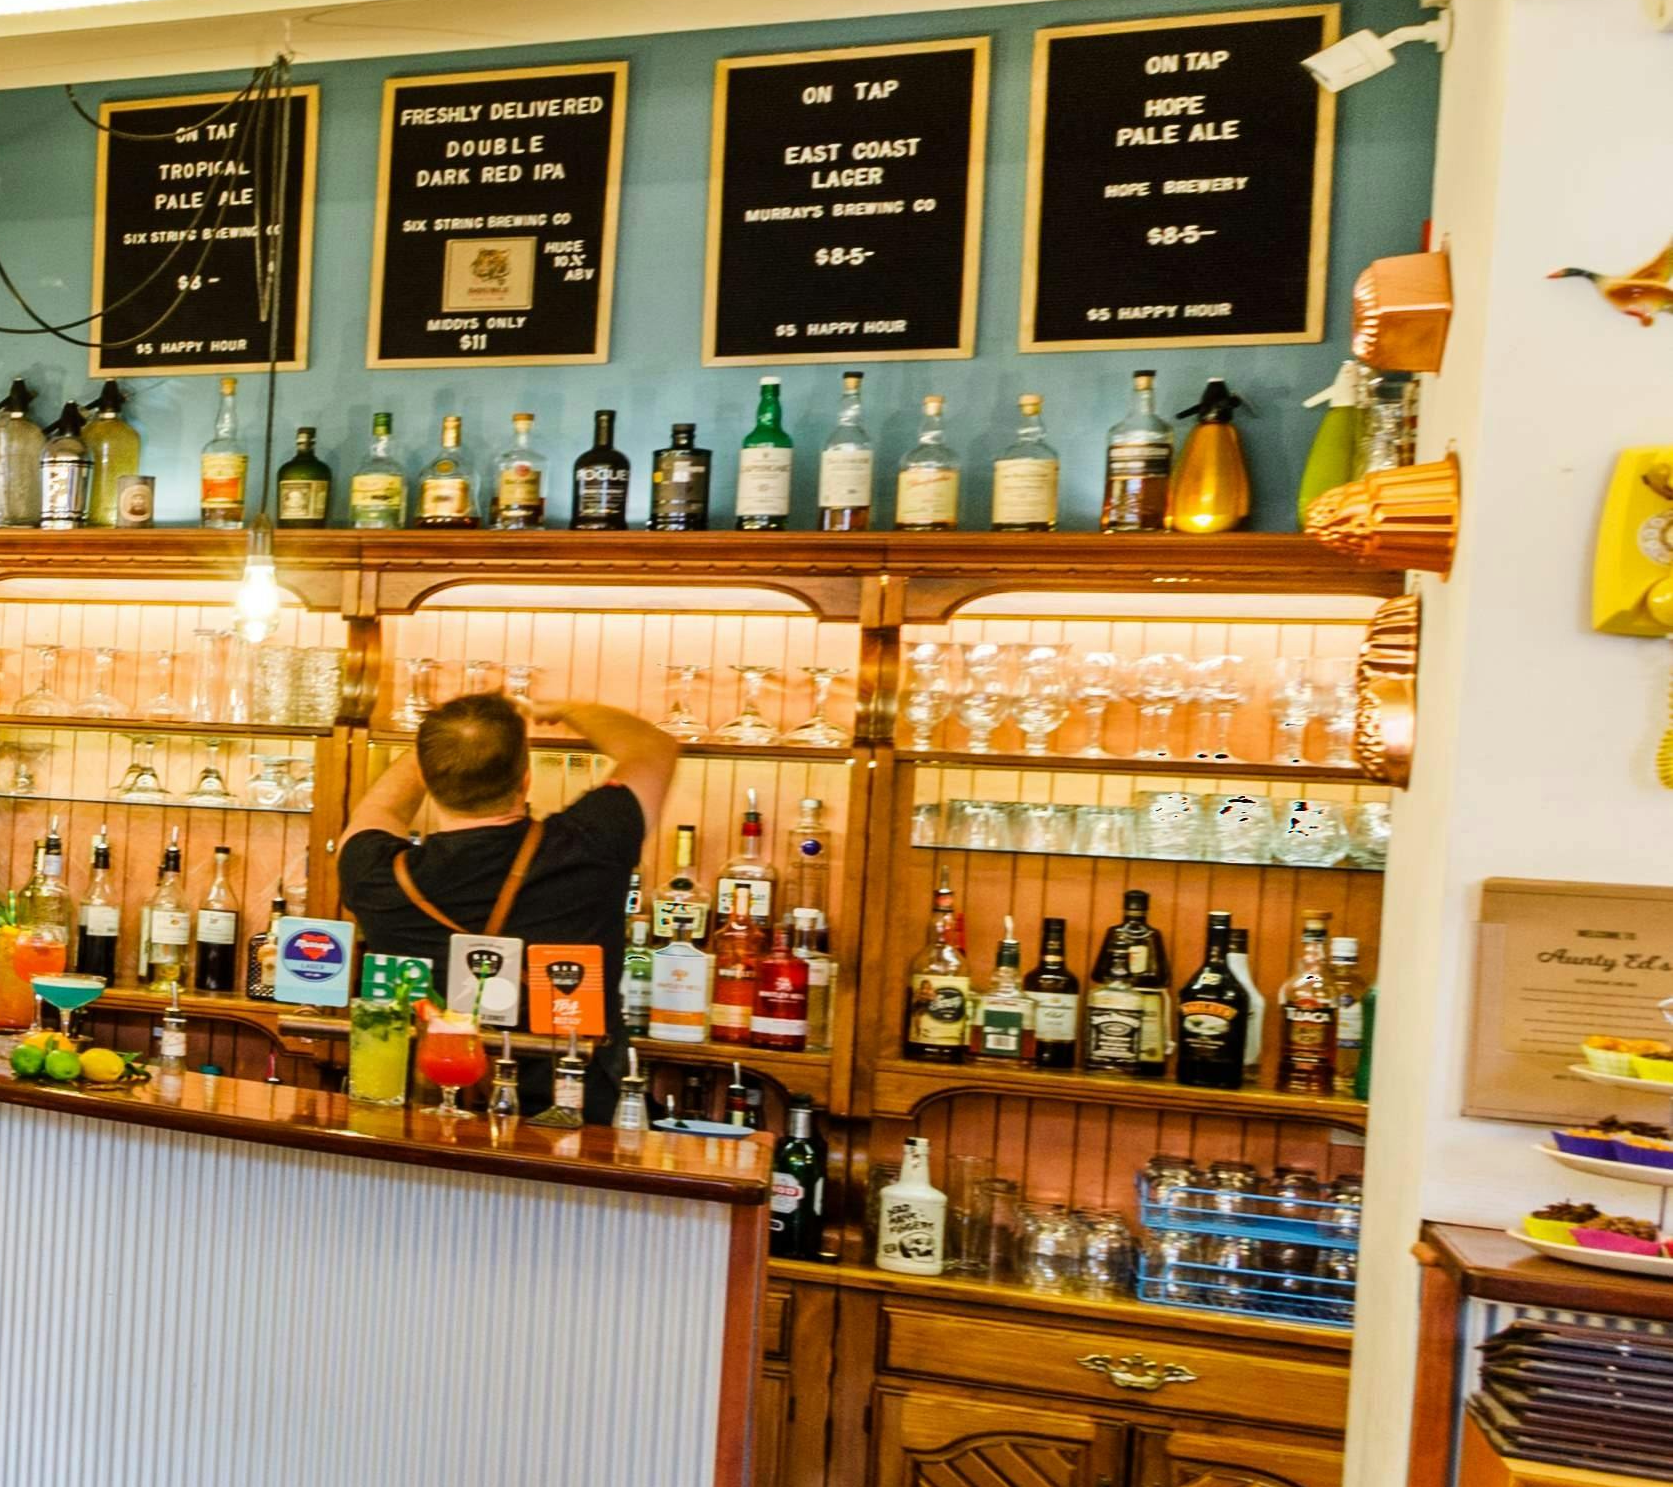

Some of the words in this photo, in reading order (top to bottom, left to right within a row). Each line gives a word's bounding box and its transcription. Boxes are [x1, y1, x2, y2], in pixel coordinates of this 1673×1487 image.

[1145, 54, 1180, 75] ON
[1184, 50, 1230, 71] TAP
[802, 85, 833, 104] ON
[854, 79, 900, 100] TAP
[400, 104, 482, 126] FRESHLY
[490, 96, 604, 121] DELIVERED
[1145, 95, 1206, 118] HOPE
[1116, 124, 1180, 147] PALE
[1188, 120, 1241, 142] ALE
[446, 135, 545, 158] DOUBLE
[785, 143, 842, 165] EAST
[852, 137, 922, 160] COAST
[416, 168, 470, 187] DARK
[481, 165, 522, 184] RED
[533, 163, 565, 180] IPA
[811, 167, 884, 189] LAGER
[1104, 182, 1151, 198] HOPE
[1163, 176, 1250, 194] BREWERY
[155, 192, 204, 210] PALE
[218, 188, 253, 206] ALE
[833, 200, 905, 217] BREWING
[913, 199, 937, 212] CO
[403, 219, 427, 233] SIX
[434, 216, 483, 231] STRING
[487, 214, 547, 229] BREWING
[552, 212, 571, 225] CO
[123, 232, 147, 245] SIX
[544, 241, 584, 254] HUGE
[1087, 308, 1111, 321] $5
[1118, 305, 1178, 320] HAPPY
[1184, 303, 1232, 317] HOUR
[427, 318, 480, 331] MIDDYS
[486, 316, 527, 328] ONLY
[776, 324, 797, 336] $5
[807, 322, 859, 336] HAPPY
[863, 320, 907, 334] HOUR
[137, 343, 153, 355] $5
[161, 340, 204, 353] HAPPY
[211, 340, 247, 352] HOUR
[460, 334, 487, 350] $11
[1537, 948, 1618, 972] Aunty
